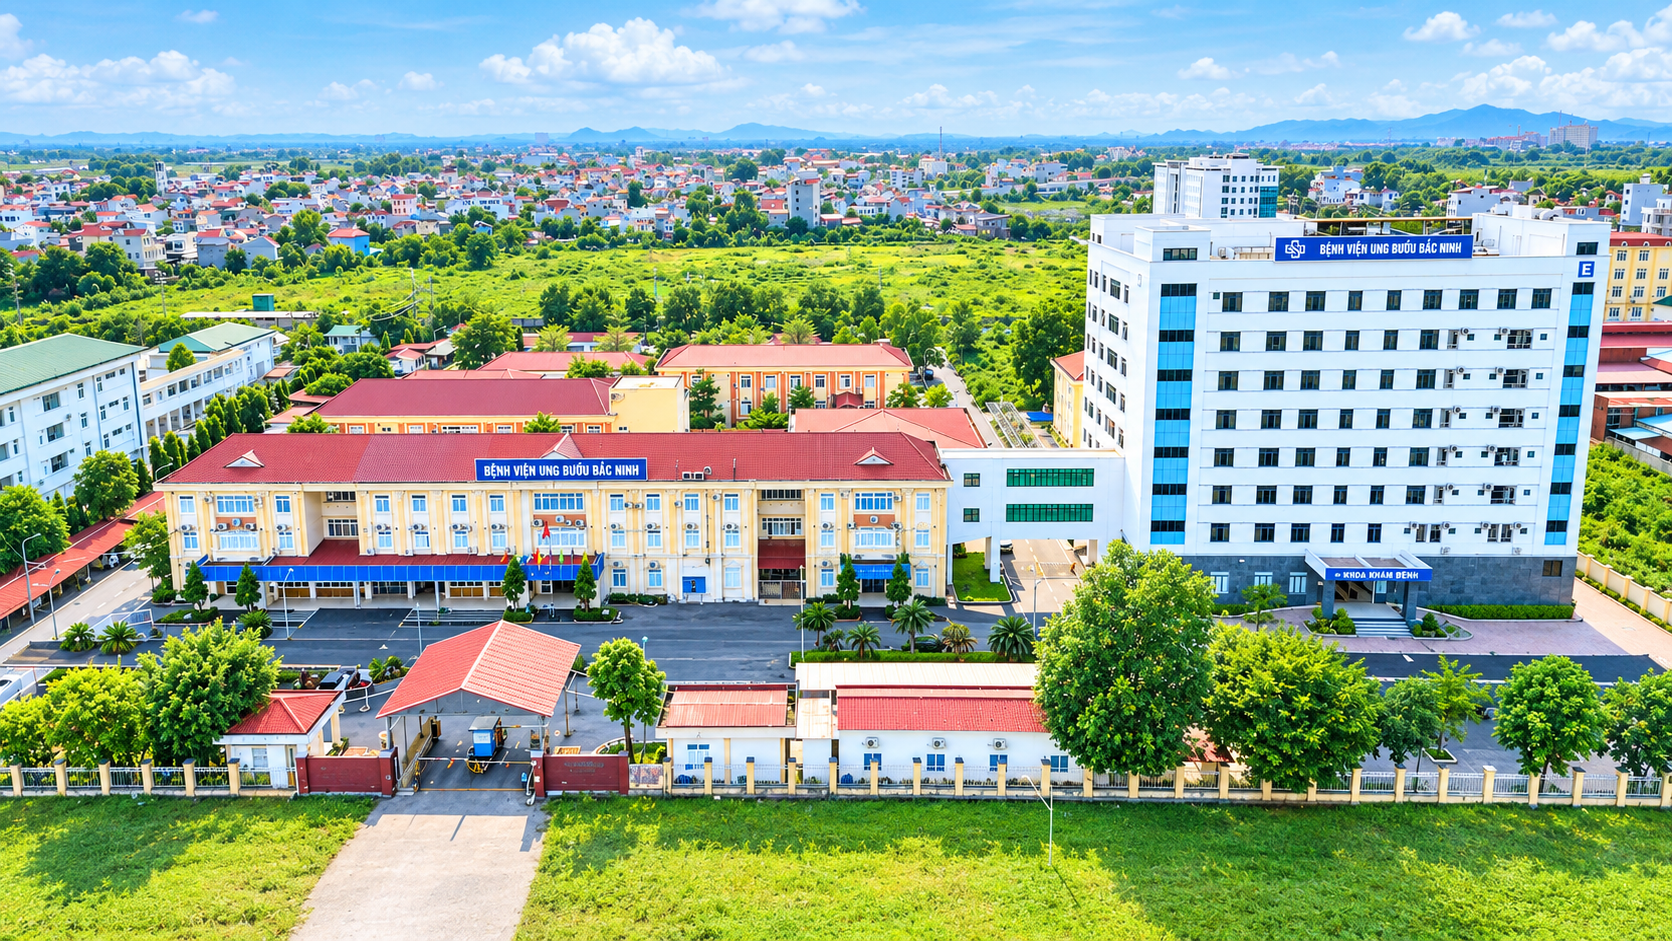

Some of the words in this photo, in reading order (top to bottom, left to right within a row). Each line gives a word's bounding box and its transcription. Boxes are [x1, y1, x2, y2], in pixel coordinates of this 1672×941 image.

[1320, 241, 1344, 258] BỆNH
[1346, 240, 1368, 258] VIỆN
[1370, 243, 1389, 254] UNG
[1439, 242, 1462, 253] NINH
[1581, 263, 1592, 276] E
[484, 462, 511, 479] BỆNH
[513, 462, 536, 479] VIỆN
[538, 465, 560, 477] UNG
[615, 464, 639, 476] NINH
[1342, 571, 1367, 579] KHOA
